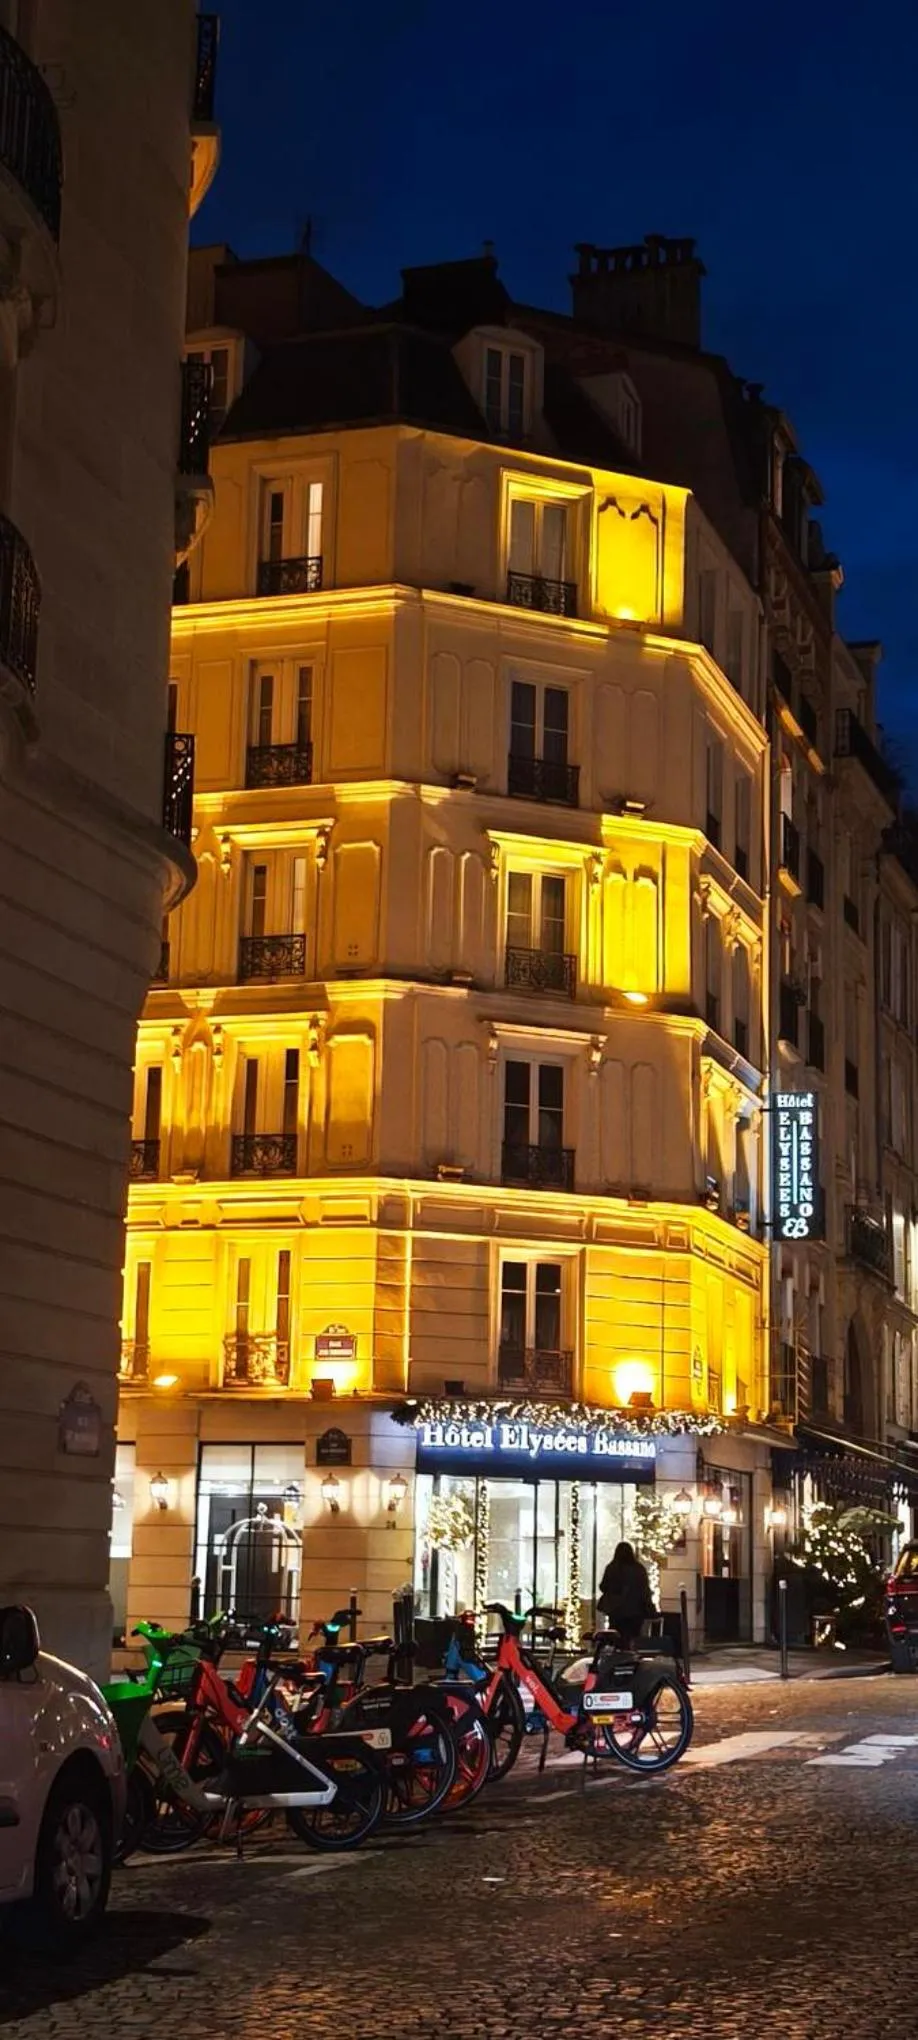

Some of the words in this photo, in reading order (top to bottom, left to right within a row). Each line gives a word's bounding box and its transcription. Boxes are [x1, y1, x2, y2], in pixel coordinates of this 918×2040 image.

[776, 1093, 814, 1108] Hôtel
[778, 1111, 791, 1217] ELYSEES
[799, 1111, 813, 1217] BASSANO
[421, 1423, 494, 1448] Hôtel
[500, 1423, 587, 1458] Elysées
[591, 1431, 657, 1458] Bassano
